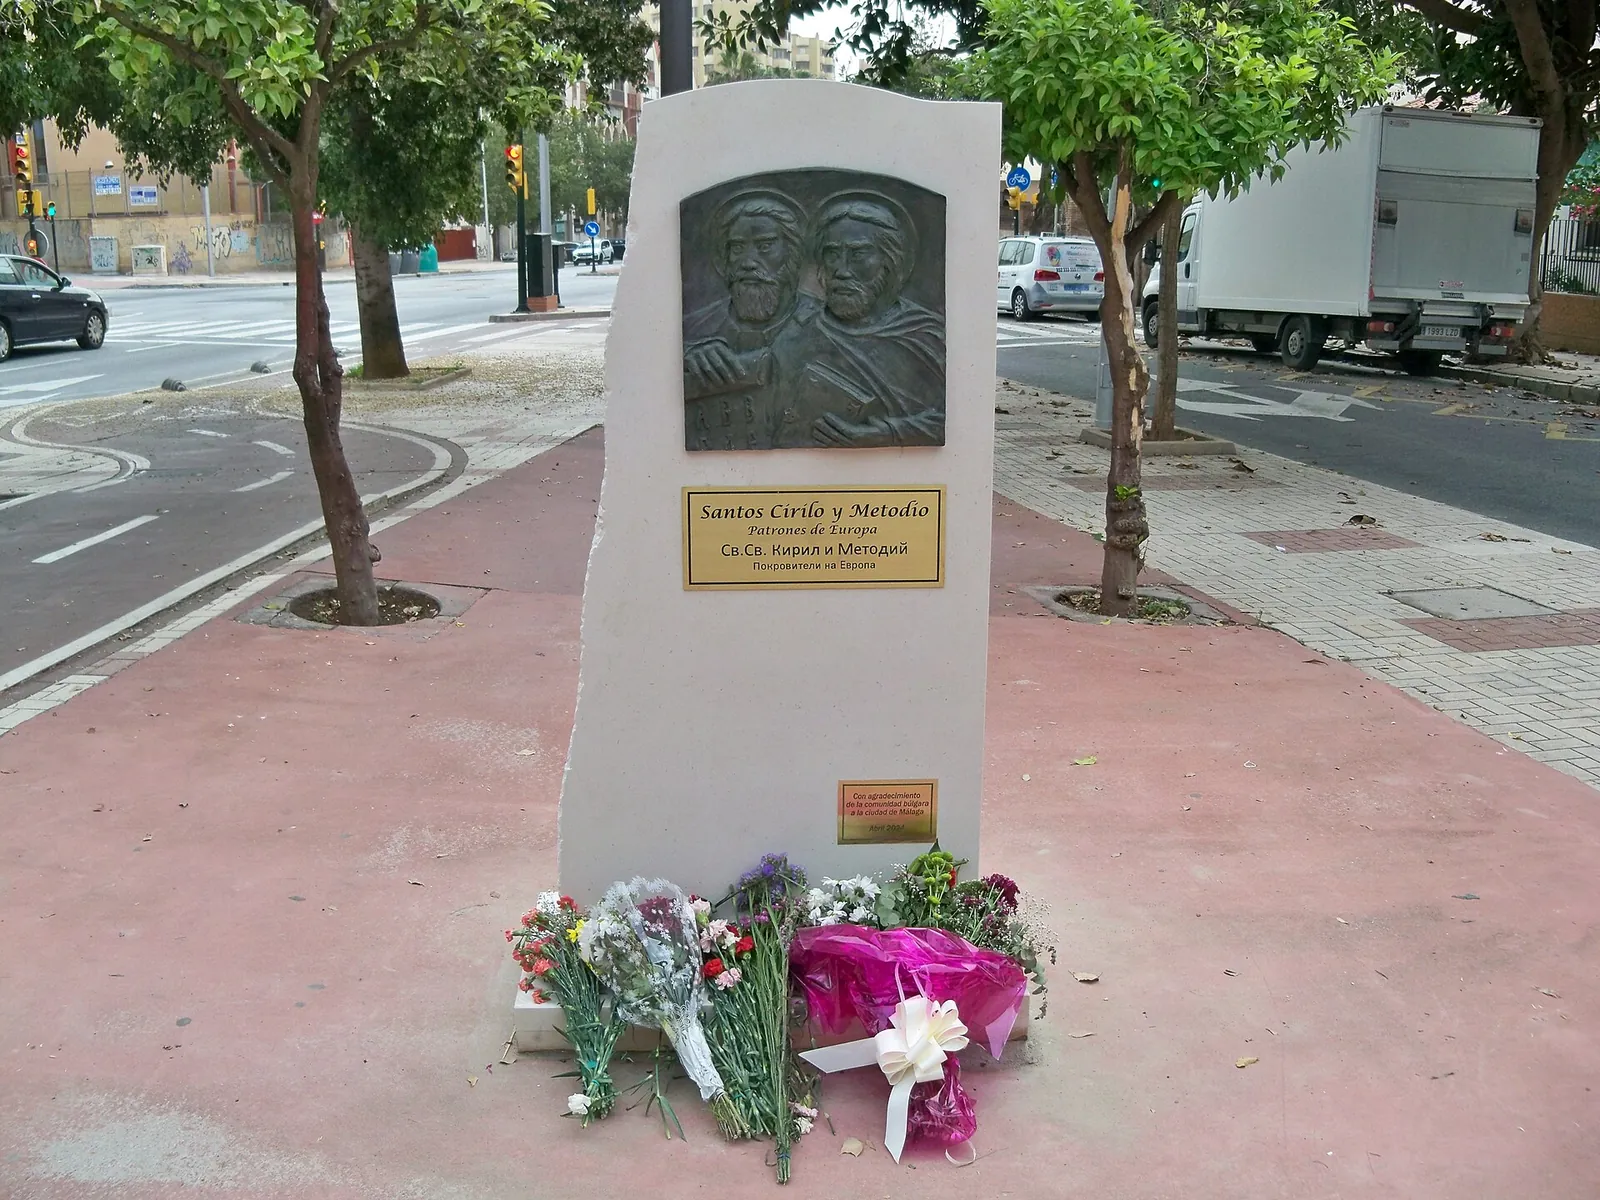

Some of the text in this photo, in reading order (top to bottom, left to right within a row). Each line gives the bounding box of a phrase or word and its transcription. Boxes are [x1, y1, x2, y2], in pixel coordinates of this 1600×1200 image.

[1427, 327, 1444, 336] 1993
[700, 500, 929, 523] Santos Cirilo y Metodio
[747, 522, 878, 539] Patrones de Europa
[721, 541, 908, 558] Св.Св. Кирил и Методий
[753, 560, 876, 572] Покровители на Европа
[852, 791, 921, 801] Con agradecimiento
[864, 800, 902, 808] comunidad
[903, 799, 929, 809] búlgara
[864, 808, 887, 816] ciudad
[888, 808, 898, 816] de
[898, 807, 924, 817] Málaga
[868, 824, 886, 832] Abril
